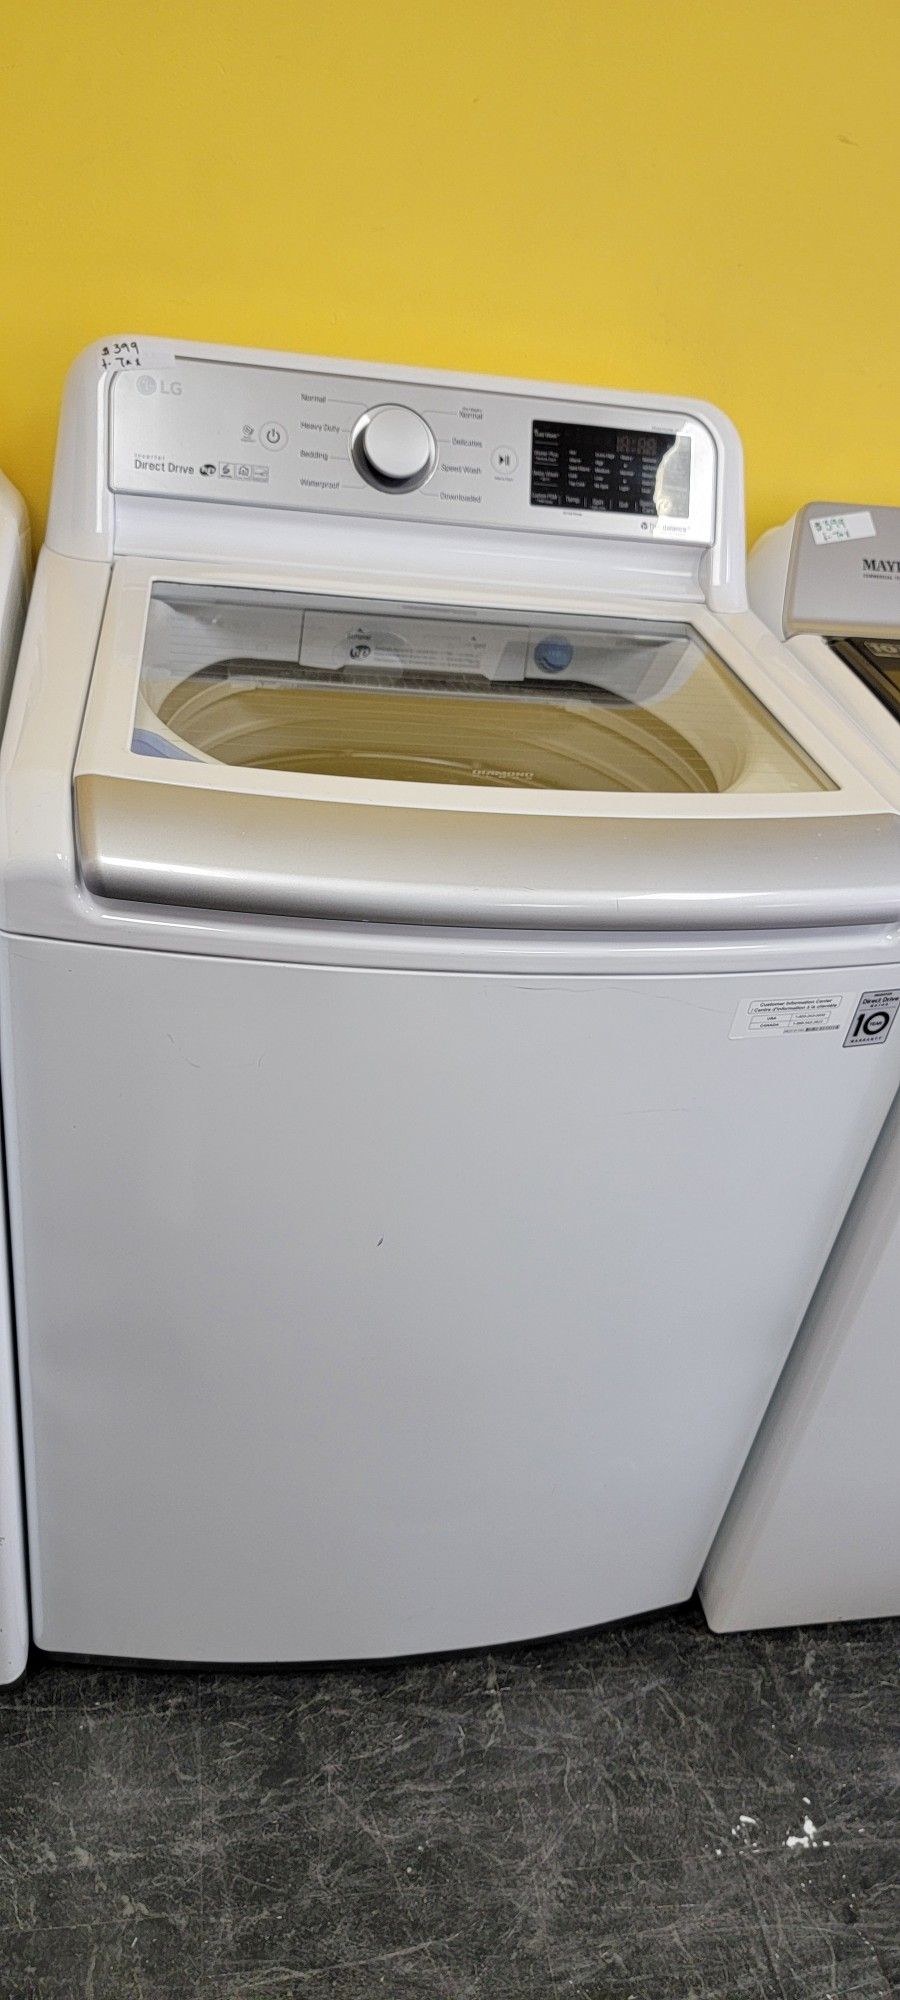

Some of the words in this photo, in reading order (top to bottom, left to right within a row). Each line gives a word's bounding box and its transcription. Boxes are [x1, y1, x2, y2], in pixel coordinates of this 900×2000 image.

[159, 381, 183, 396] LG
[301, 393, 326, 403] Normal
[459, 411, 483, 420] Normal
[300, 422, 322, 432] Heavy
[323, 424, 340, 433] Duty
[451, 437, 483, 448] Delicates
[300, 449, 328, 461] Bedding
[135, 459, 165, 473] Direct
[168, 462, 195, 475] Drive
[441, 463, 462, 475] Speed
[463, 465, 481, 475] Wash
[300, 478, 340, 489] Waterproof
[439, 492, 482, 504] Downloaded
[882, 995, 900, 1003] Drive
[852, 1011, 890, 1036] 10
